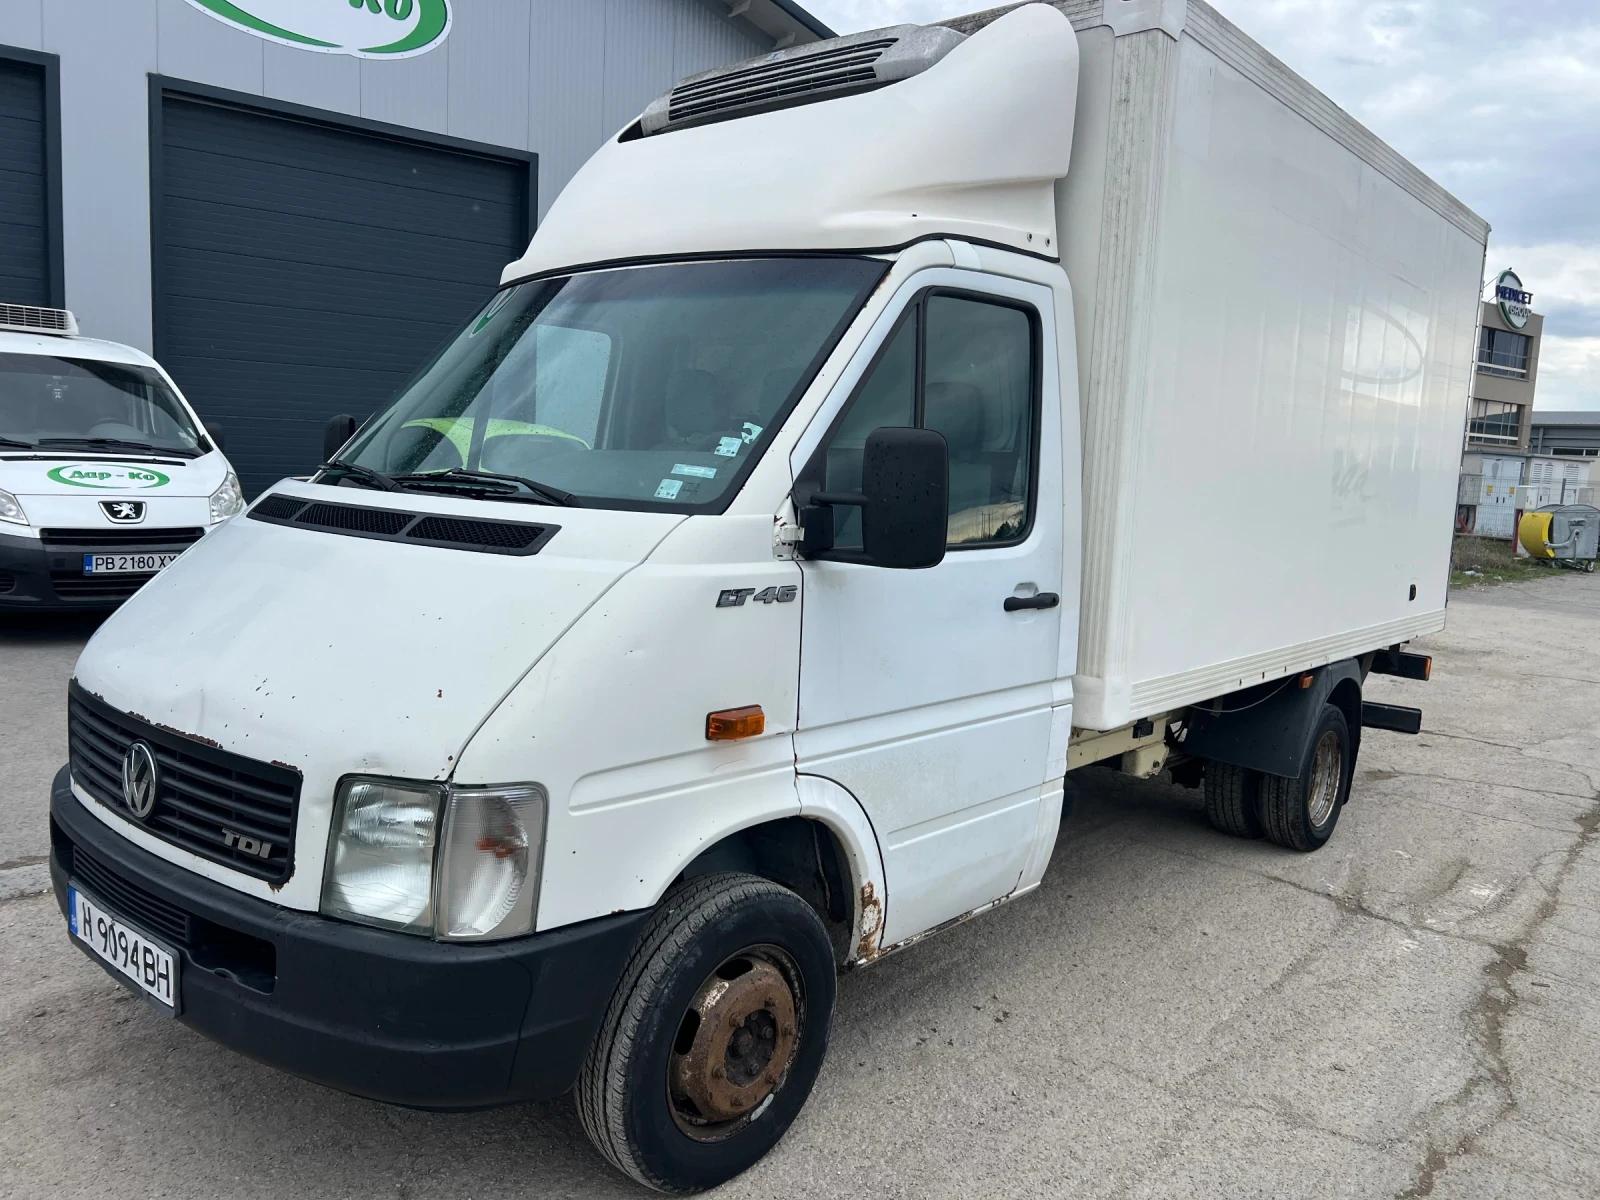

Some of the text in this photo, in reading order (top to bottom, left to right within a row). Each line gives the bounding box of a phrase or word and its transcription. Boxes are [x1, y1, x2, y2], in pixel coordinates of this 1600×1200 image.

[118, 556, 155, 570] 2180
[753, 585, 798, 604] 46
[222, 828, 273, 859] TDI
